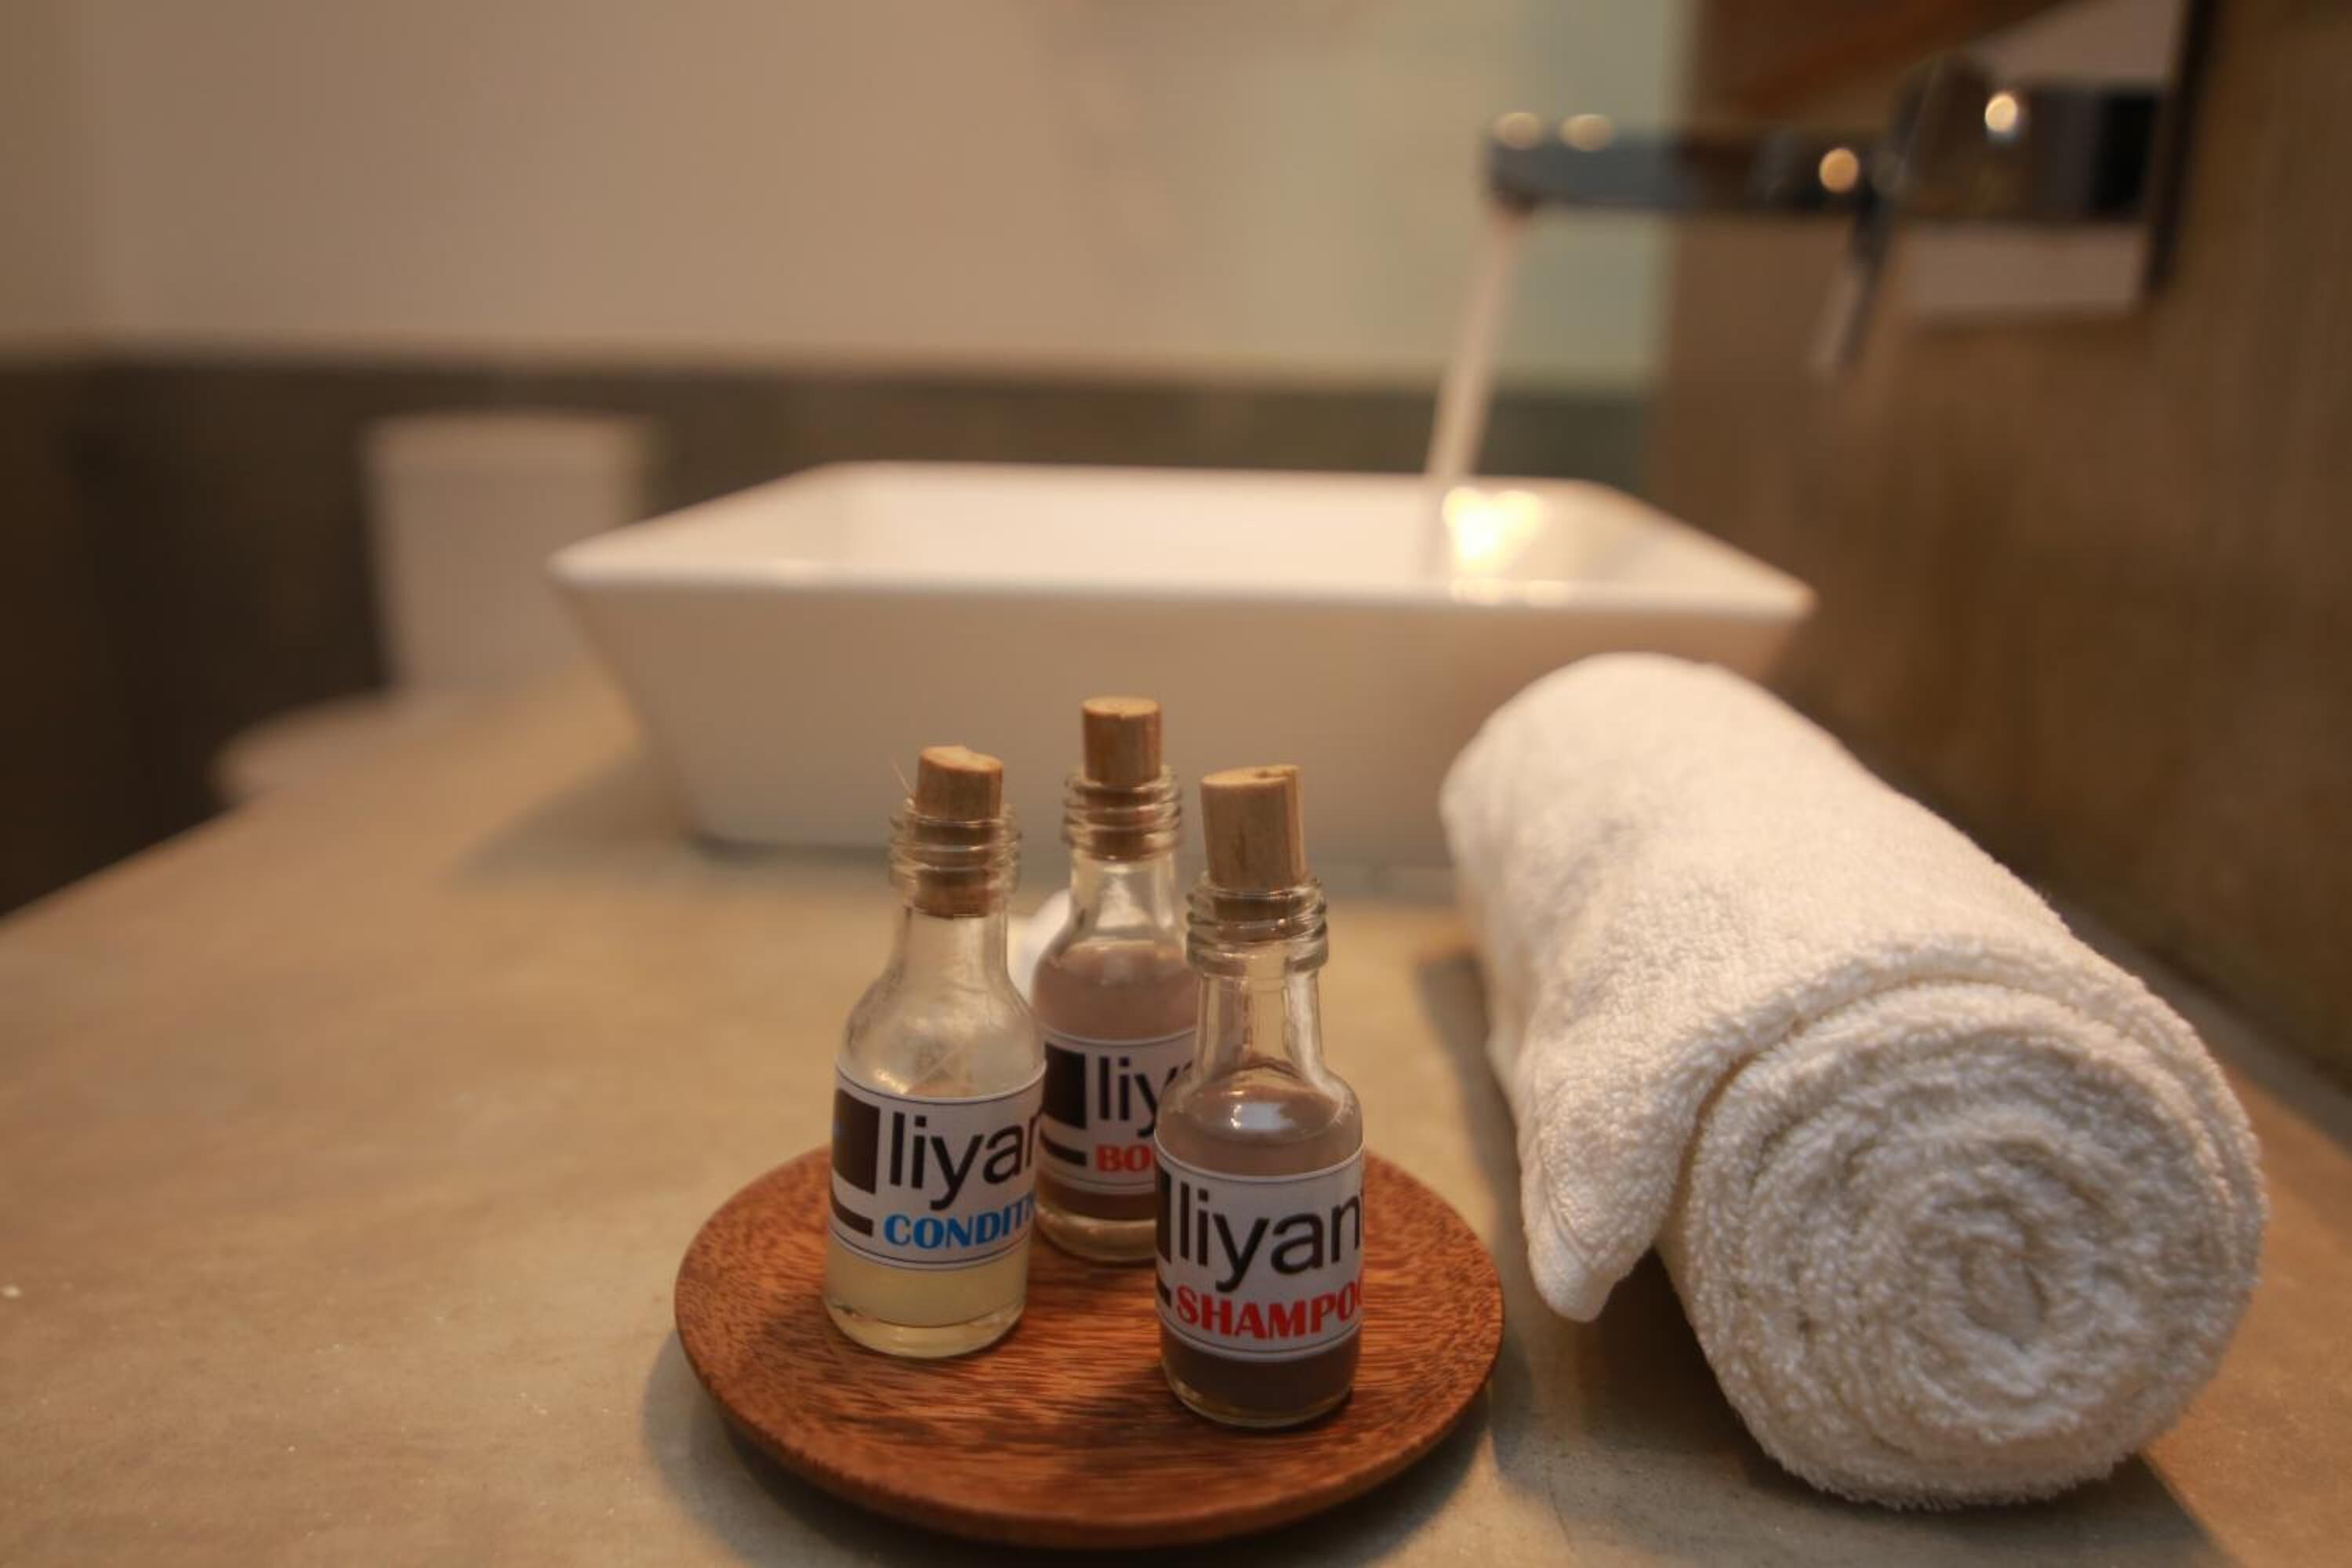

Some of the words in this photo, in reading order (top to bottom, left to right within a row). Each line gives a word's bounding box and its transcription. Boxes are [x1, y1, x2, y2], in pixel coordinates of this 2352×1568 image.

[1099, 1056, 1192, 1138] liy
[1180, 1181, 1363, 1292] liyan
[1177, 1272, 1363, 1339] SHAMPO
